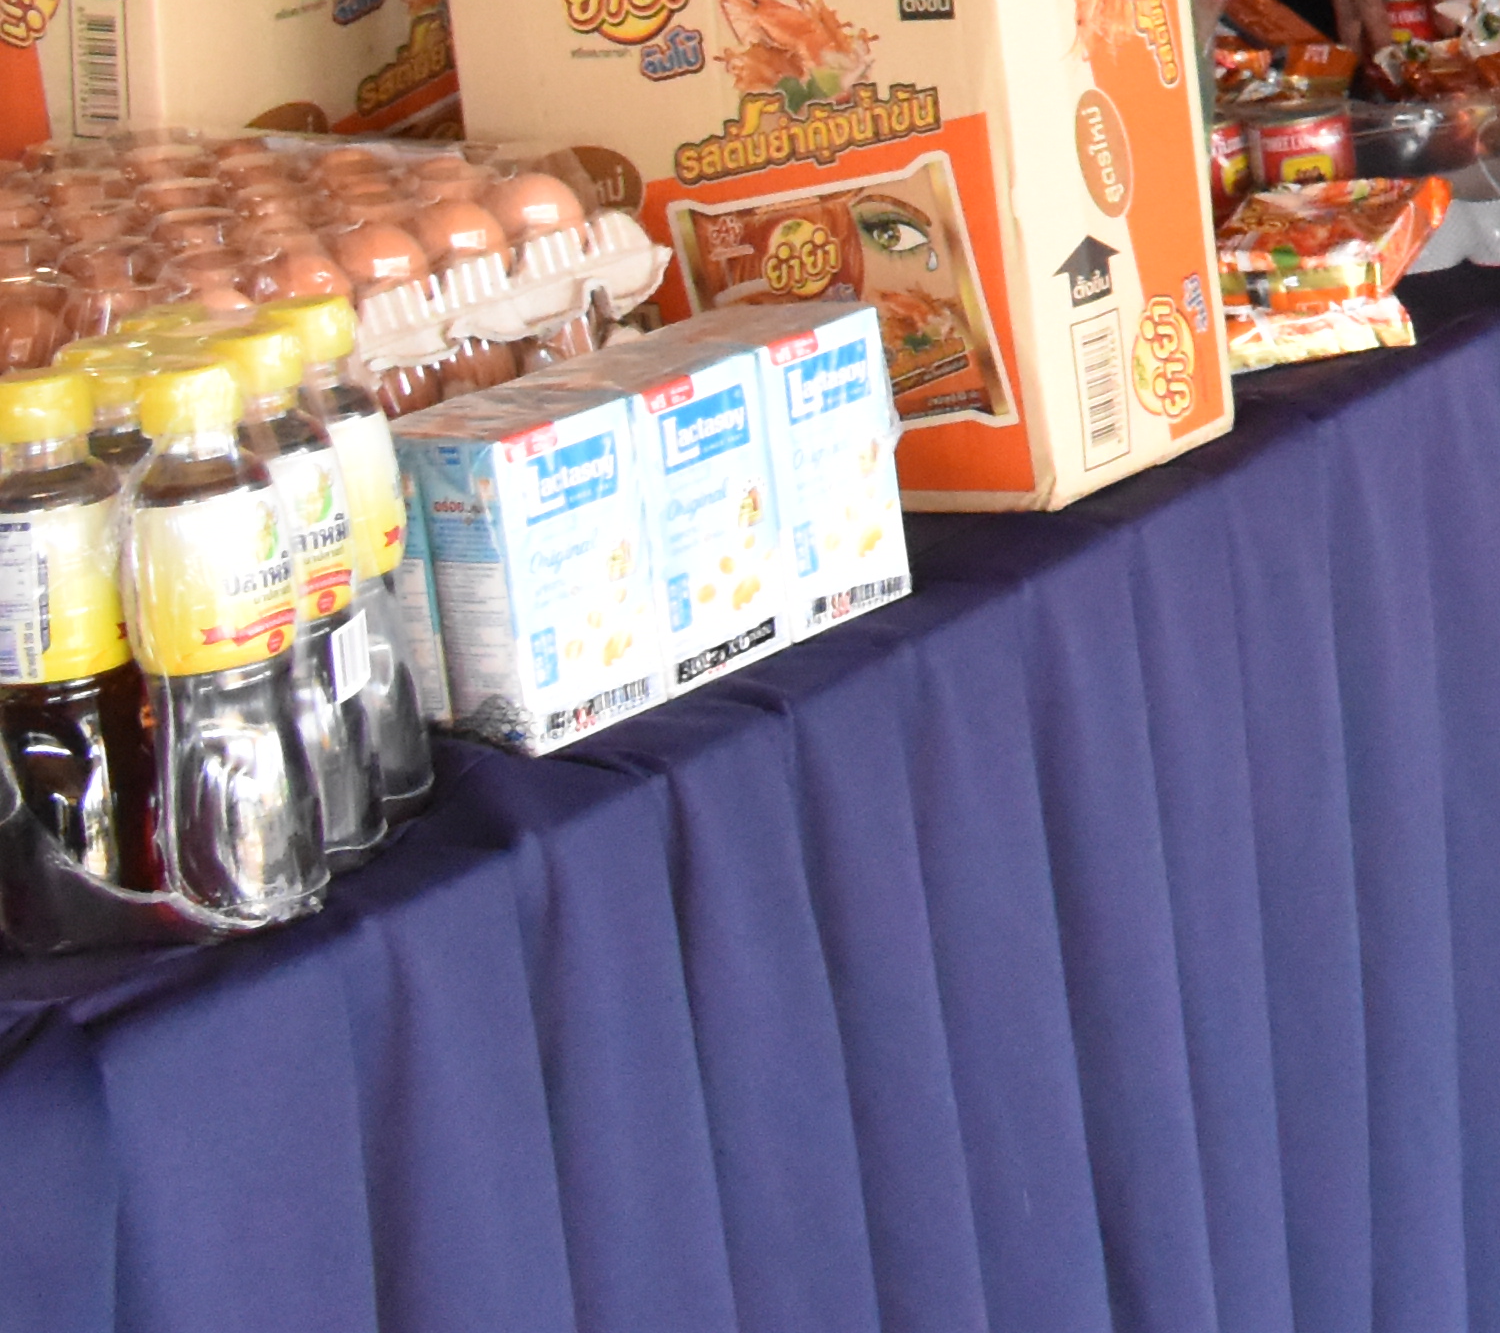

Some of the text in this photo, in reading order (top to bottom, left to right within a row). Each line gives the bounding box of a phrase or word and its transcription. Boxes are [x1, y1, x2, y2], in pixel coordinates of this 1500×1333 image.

[763, 227, 839, 294] ยำยำ
[663, 405, 745, 468] Lactasoy
[525, 450, 616, 518] Lactasoy
